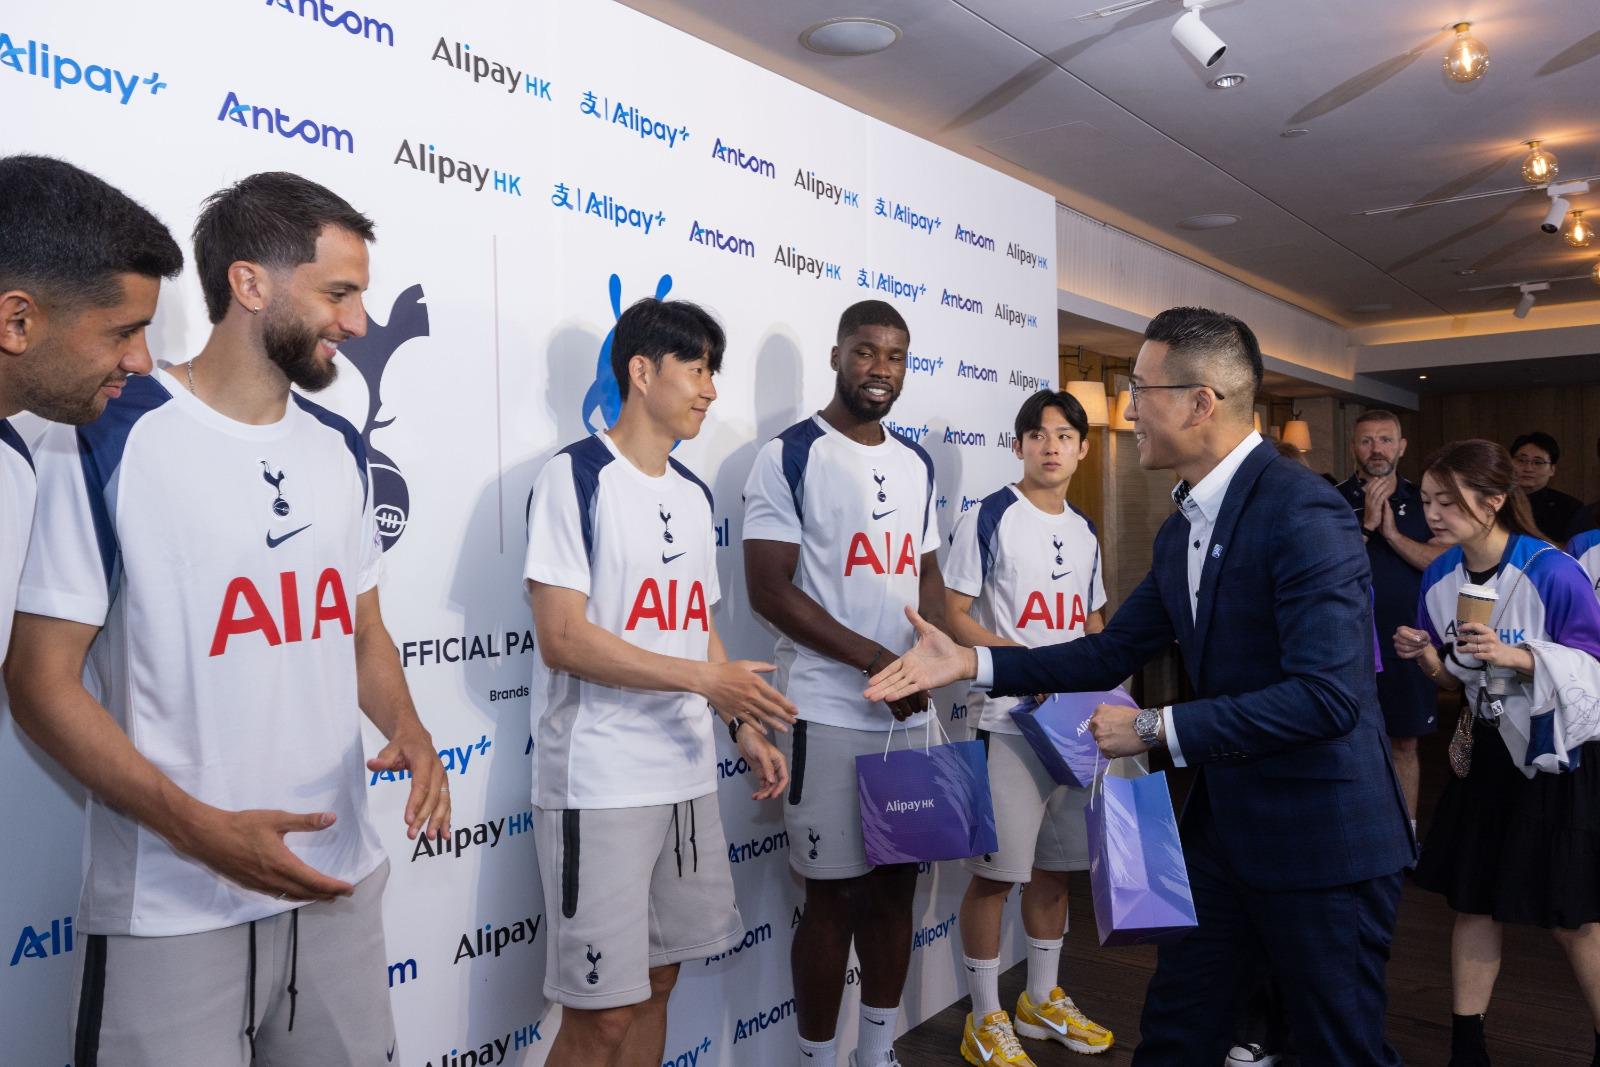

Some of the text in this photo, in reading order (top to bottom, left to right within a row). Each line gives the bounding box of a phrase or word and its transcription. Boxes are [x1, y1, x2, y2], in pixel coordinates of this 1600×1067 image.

[218, 92, 353, 153] Antom
[712, 138, 775, 179] Antom
[689, 220, 754, 257] Antom
[955, 224, 994, 252] Antom
[941, 288, 983, 315] Antom
[905, 352, 943, 376] lipay+
[957, 360, 998, 383] Antom
[943, 426, 986, 446] Antom
[846, 532, 915, 576] AIA
[209, 567, 353, 657] AIA
[624, 577, 709, 632] AIA
[1017, 591, 1086, 630] AIA
[397, 633, 500, 667] FFICIAL
[489, 686, 529, 701] Brands
[728, 830, 790, 863] Antom
[454, 914, 547, 965] Alipay
[733, 998, 797, 1045] Antom
